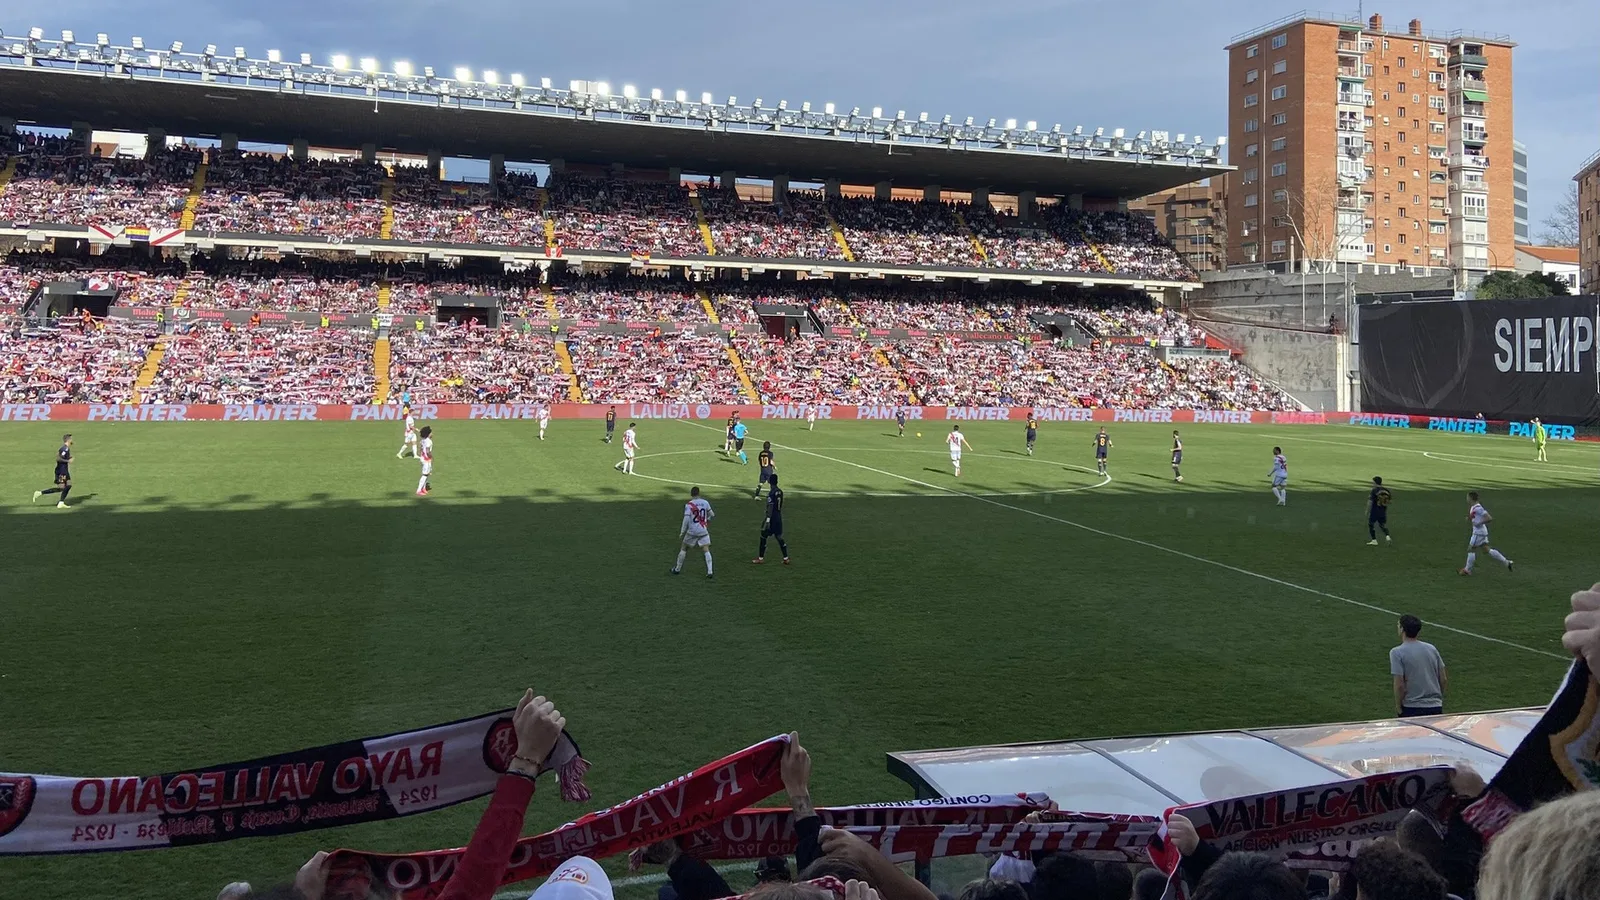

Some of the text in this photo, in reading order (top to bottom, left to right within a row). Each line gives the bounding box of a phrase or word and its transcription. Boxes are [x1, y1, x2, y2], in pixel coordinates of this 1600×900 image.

[87, 404, 188, 421] PANTER
[223, 404, 317, 420] PANTER
[469, 404, 546, 419] PANTE
[630, 403, 690, 419] LALIGA
[762, 405, 832, 419] PANTR
[945, 406, 1009, 420] PANTER
[1032, 407, 1093, 421] PANTER
[1113, 409, 1172, 423] PANTER
[1193, 409, 1251, 423] PANTER
[1350, 413, 1410, 428] PANTER
[1428, 417, 1486, 434] PANTER
[1205, 774, 1427, 839] VALLECANO
[1287, 827, 1345, 846] NUESTRO
